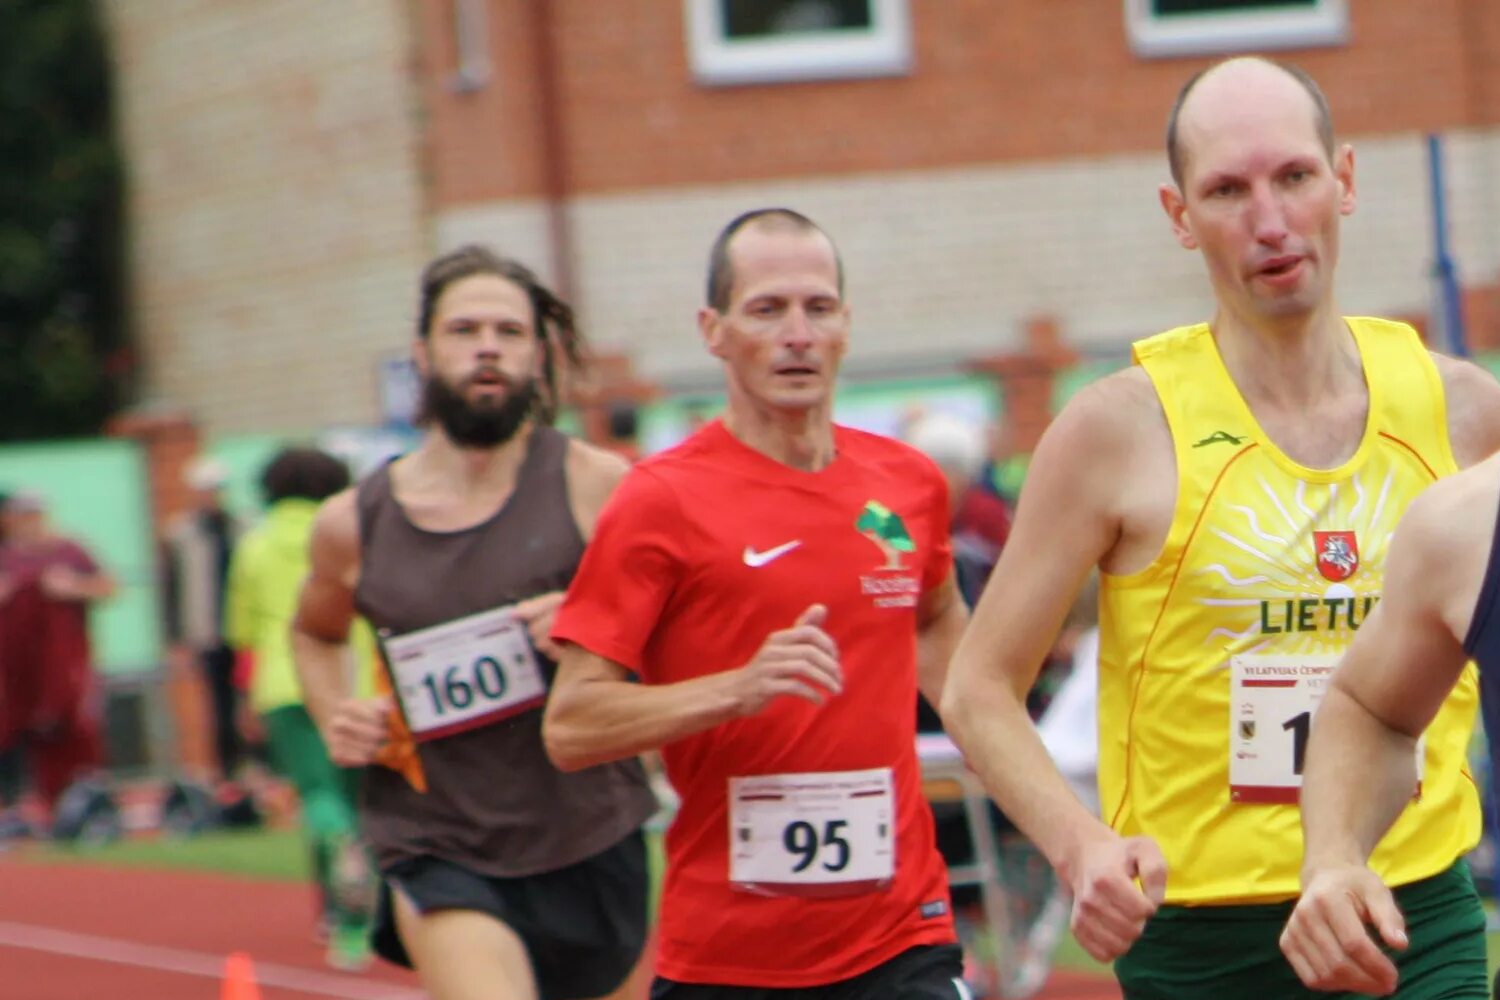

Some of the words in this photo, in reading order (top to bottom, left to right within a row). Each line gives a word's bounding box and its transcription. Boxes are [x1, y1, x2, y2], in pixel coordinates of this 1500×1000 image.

[1261, 597, 1380, 634] LIETU
[421, 655, 508, 716] 160
[1255, 666, 1298, 676] LATVIJAS
[782, 820, 850, 873] 95
